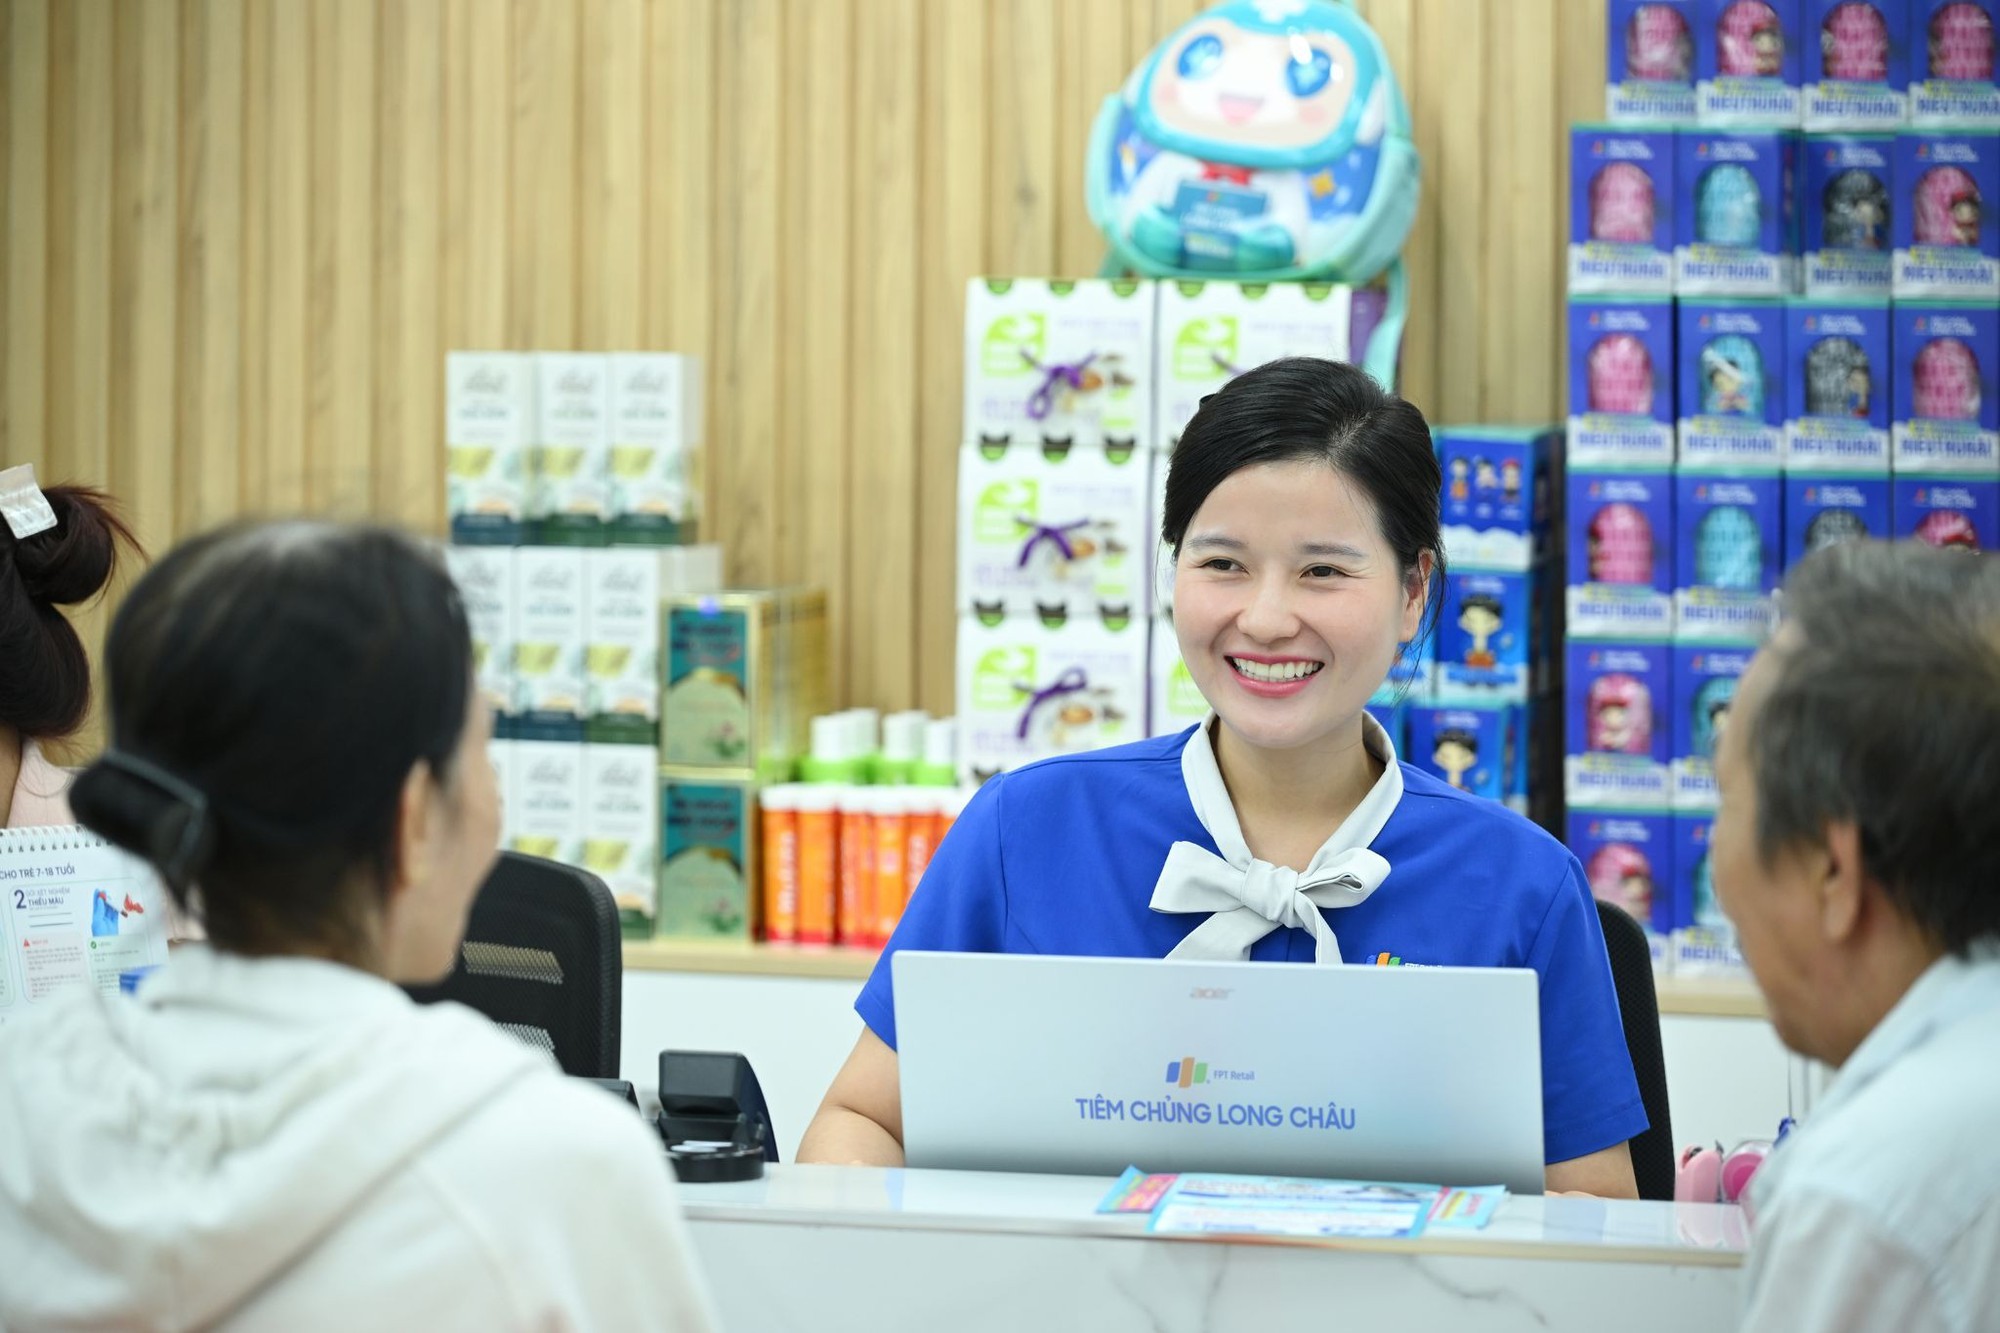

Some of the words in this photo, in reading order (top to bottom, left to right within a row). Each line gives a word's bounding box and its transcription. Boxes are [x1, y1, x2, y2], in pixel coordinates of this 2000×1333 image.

[0, 869, 18, 880] CHO
[19, 867, 35, 879] TRẺ
[55, 862, 76, 876] TUỔI
[14, 889, 27, 909] 2
[1213, 1070, 1228, 1080] FPT
[1230, 1070, 1256, 1081] Retail
[1075, 1094, 1124, 1120] TIÊM
[1130, 1095, 1212, 1124] CHỦNG
[1217, 1103, 1284, 1127] LONG
[1290, 1102, 1356, 1130] CHÂU
